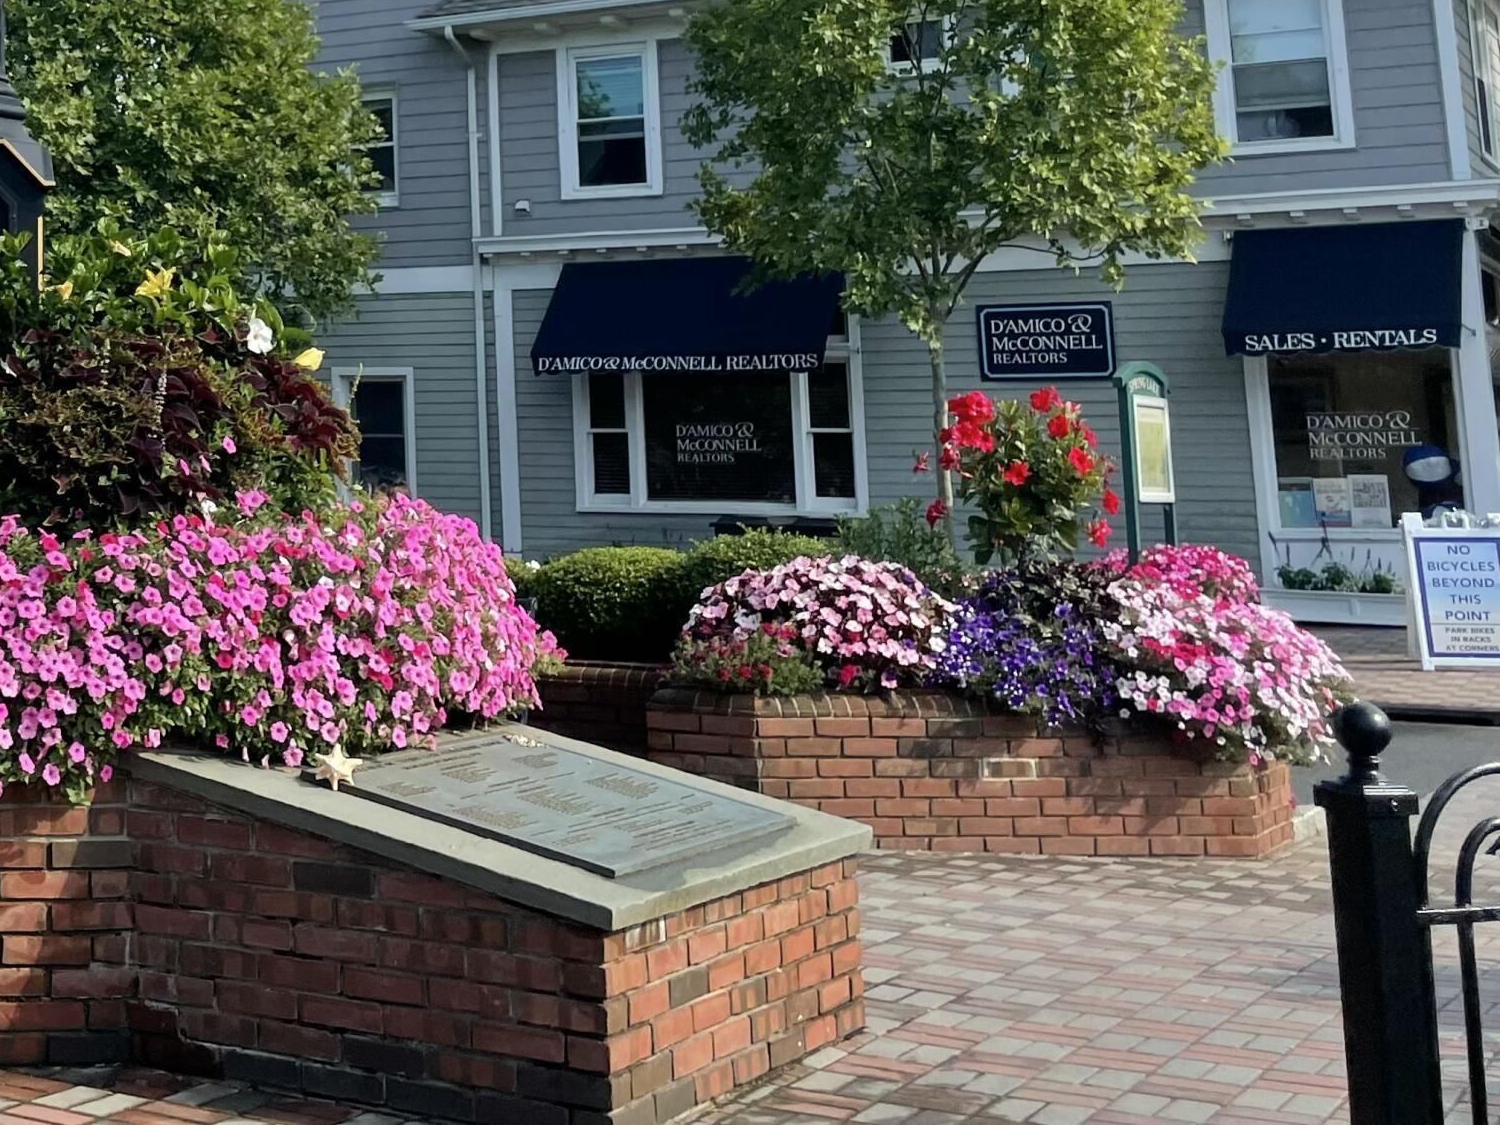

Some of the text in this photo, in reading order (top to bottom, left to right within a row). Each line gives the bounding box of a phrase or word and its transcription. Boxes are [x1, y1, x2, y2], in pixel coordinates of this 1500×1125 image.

[990, 313, 1092, 335] D'AMICO &
[992, 334, 1104, 351] McCONNELL
[1245, 328, 1438, 351] SALES RENTALS
[538, 357, 601, 371] D'AMICO
[621, 356, 722, 371] McCONNELL
[726, 354, 819, 370] REALTORS
[993, 352, 1068, 364] REALTORS
[1306, 410, 1410, 429] D'AMICO &
[676, 422, 755, 438] D'AMICO &
[1308, 431, 1423, 446] McCONNELL
[677, 439, 762, 451] McCONNELL
[677, 453, 735, 464] REALTORS
[1310, 448, 1387, 460] REALTORS
[1447, 545, 1470, 555] NO
[1427, 561, 1495, 572] BICYCLES
[1432, 577, 1495, 588] BEYOND
[1449, 594, 1482, 605] THIS
[1445, 610, 1491, 621] POINT
